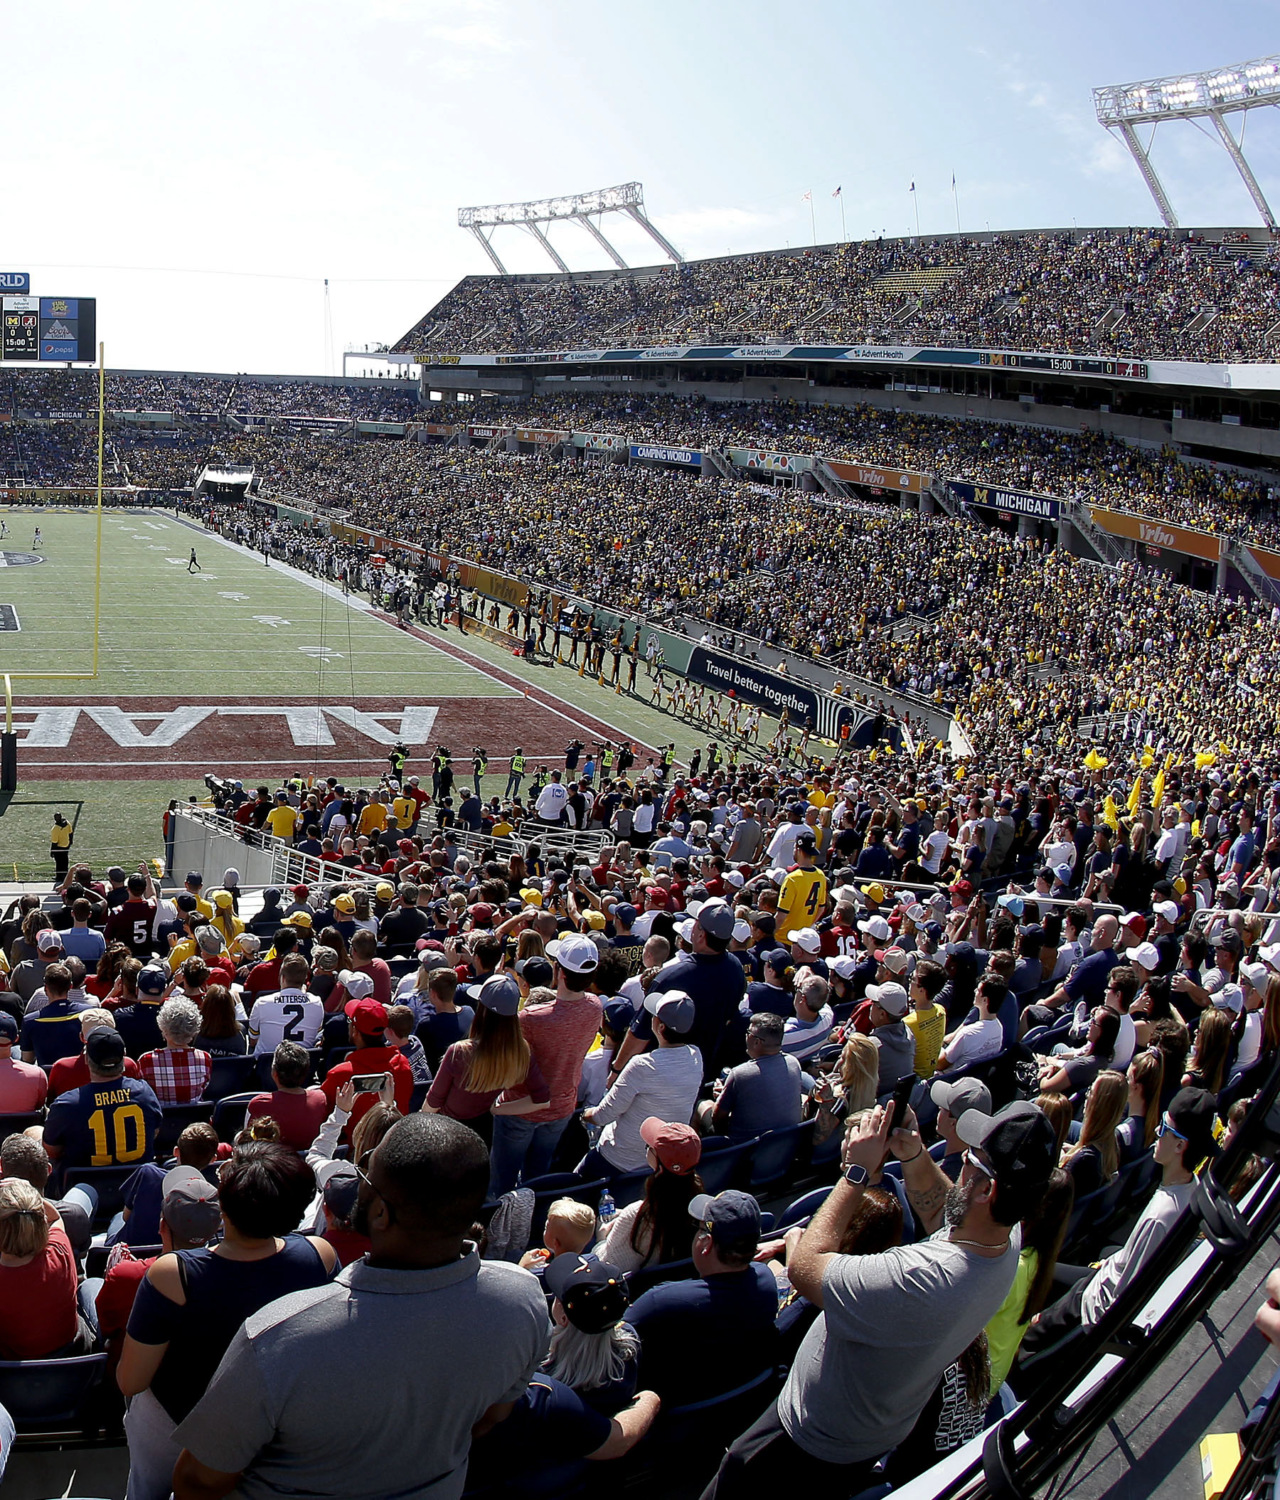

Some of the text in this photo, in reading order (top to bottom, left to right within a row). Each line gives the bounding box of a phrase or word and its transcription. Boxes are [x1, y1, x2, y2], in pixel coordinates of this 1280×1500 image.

[414, 356, 462, 364] FUN SPOT
[649, 350, 679, 358] AdventHealth
[745, 348, 782, 357] AdventHealth
[861, 350, 904, 360] AdventHealth
[1010, 355, 1017, 366] 0
[1050, 358, 1072, 370] 15:00
[1106, 362, 1112, 374] 0
[49, 411, 83, 419] MICHIGAN
[637, 447, 692, 463] CAMPING WORLD
[857, 468, 885, 485] Vrbo
[974, 487, 988, 504] M
[995, 492, 1051, 516] MICHIGAN
[1138, 522, 1176, 547] Vrbo
[489, 576, 517, 602] Vrbo
[705, 659, 809, 714] Travel better together
[403, 804, 410, 818] 1
[804, 881, 821, 916] 4
[133, 920, 147, 944] 5
[836, 935, 856, 960] 16
[273, 995, 310, 1004] PATTERSON
[282, 1004, 305, 1041] 2
[94, 1088, 131, 1107] BRADY
[87, 1103, 146, 1167] 10
